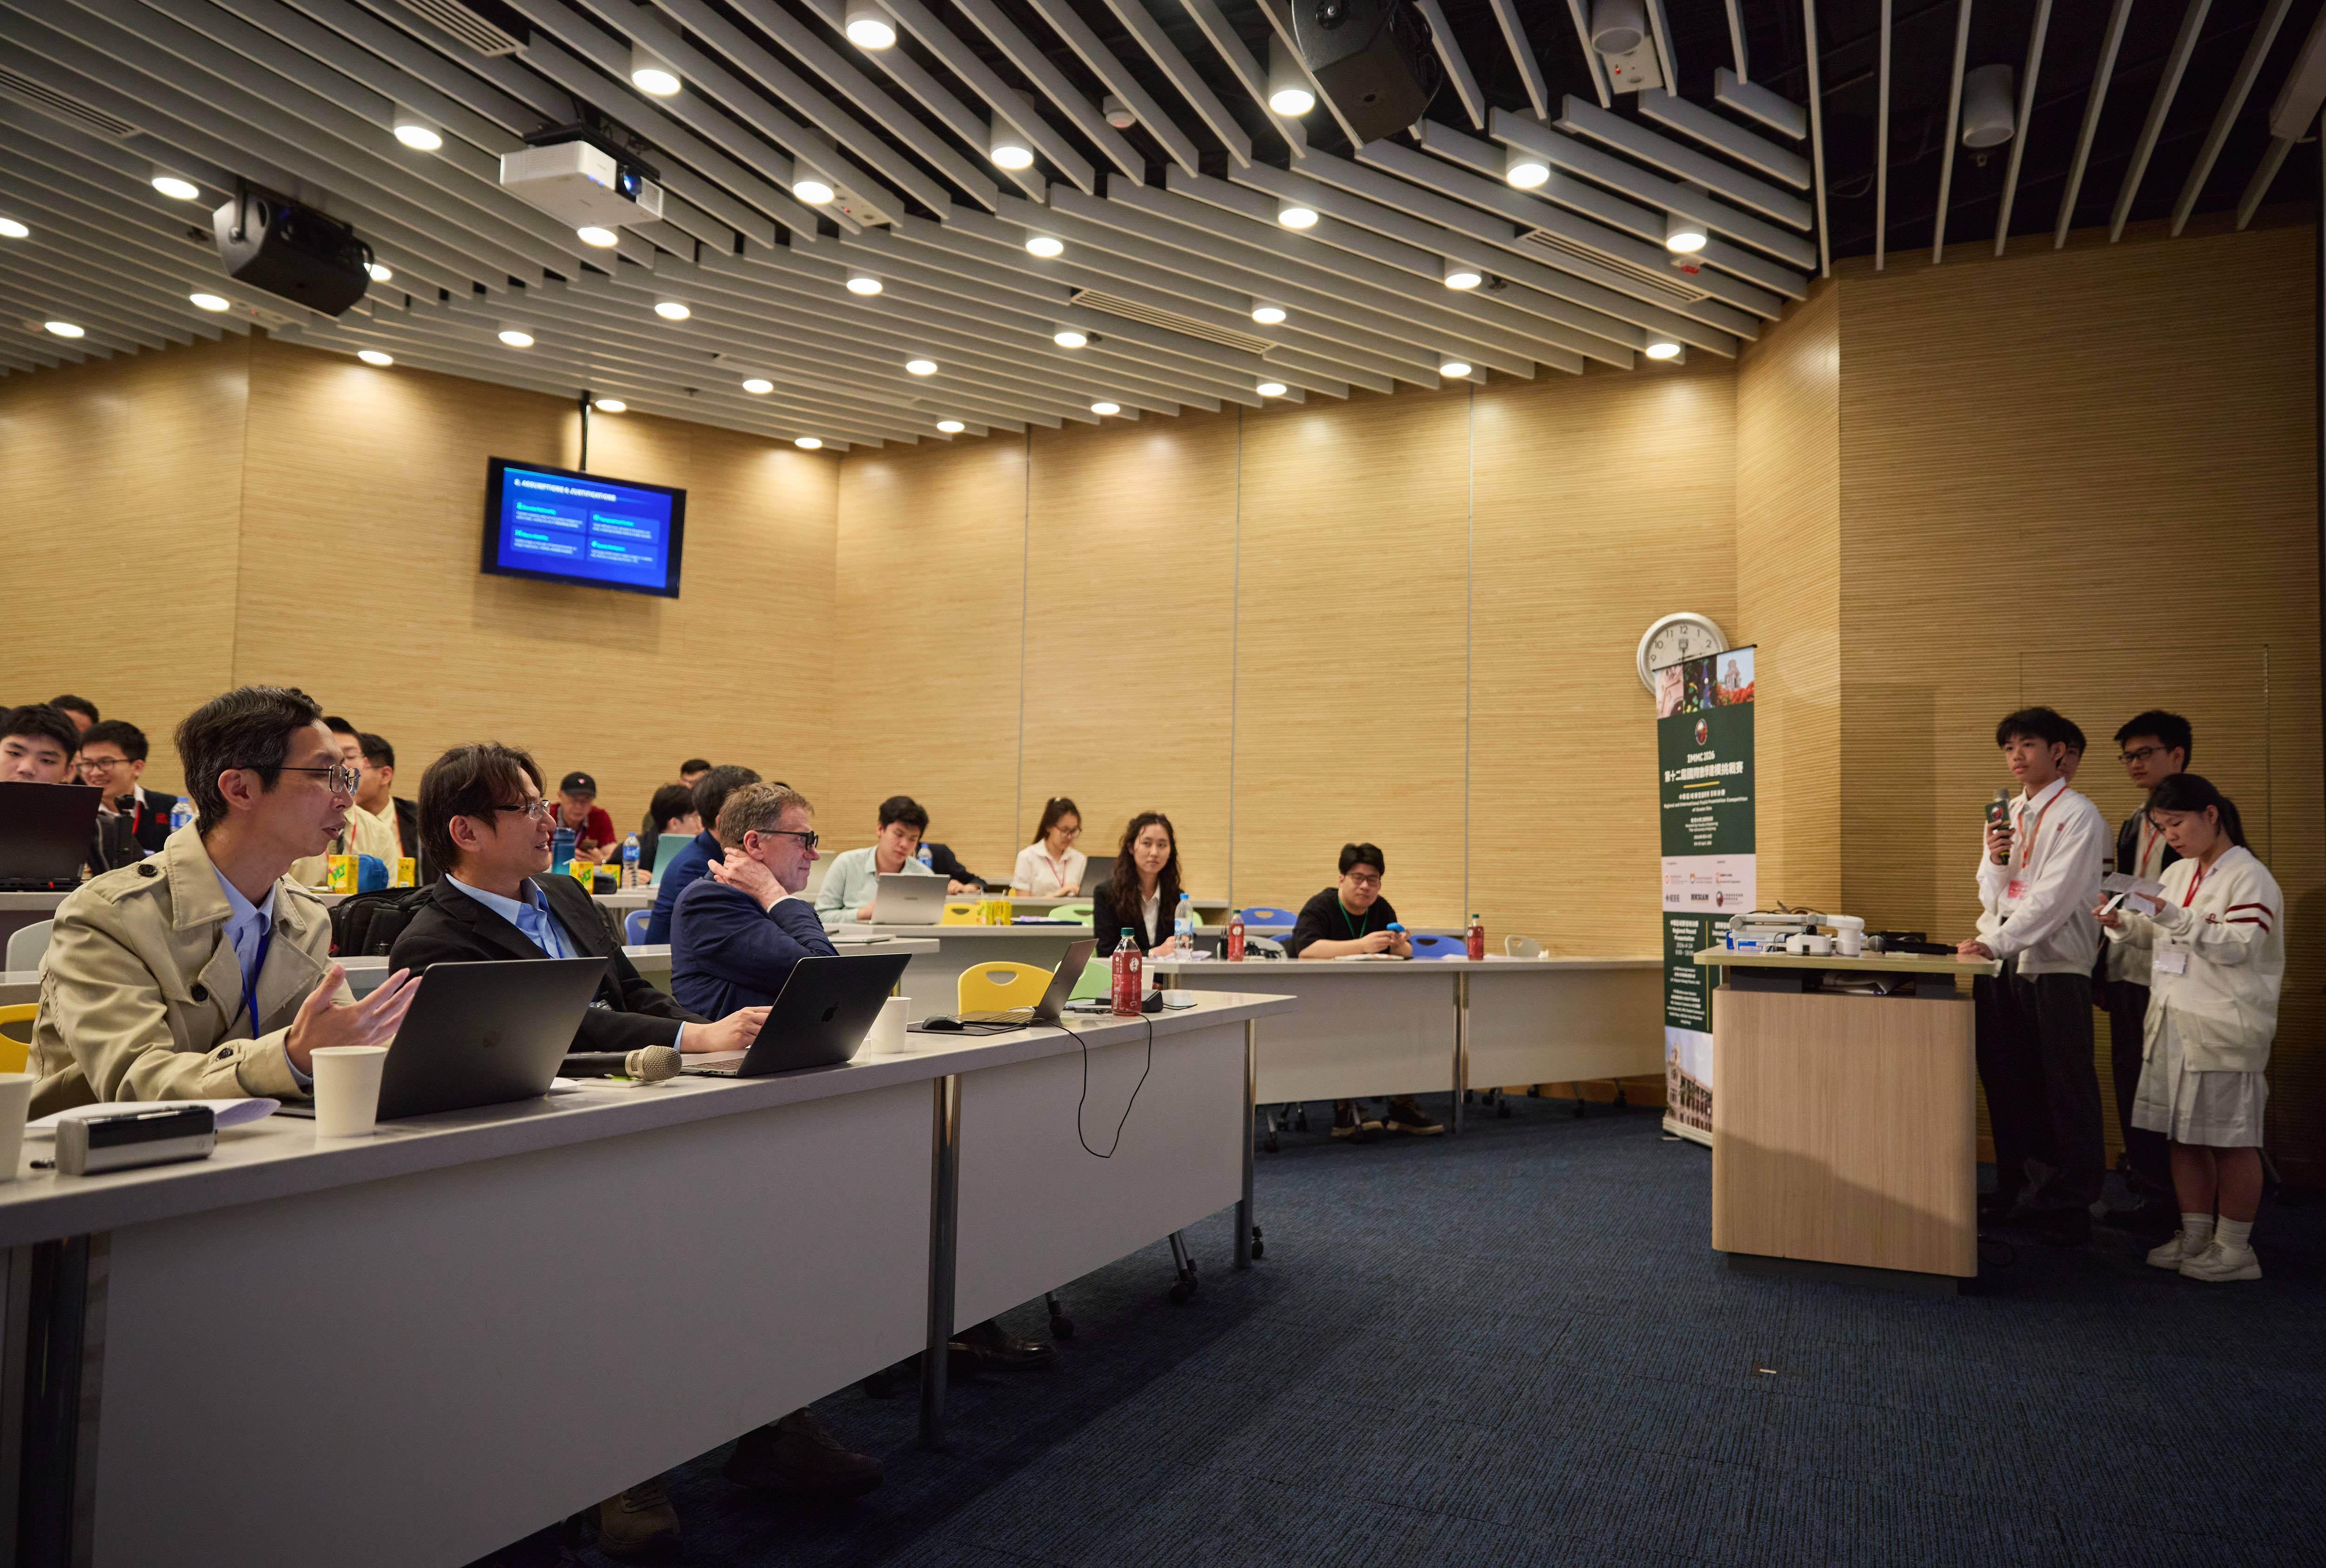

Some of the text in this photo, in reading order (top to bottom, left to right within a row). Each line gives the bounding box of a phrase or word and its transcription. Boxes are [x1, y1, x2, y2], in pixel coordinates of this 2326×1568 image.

[521, 480, 564, 493] ASSUMPTIONS
[569, 488, 616, 501] JUSTIFICATIONS
[1680, 625, 1688, 634] 12
[1697, 628, 1700, 637] 1
[1655, 640, 1664, 649] 10
[1706, 640, 1712, 648] 2
[1687, 751, 1715, 763] IMMC 2026
